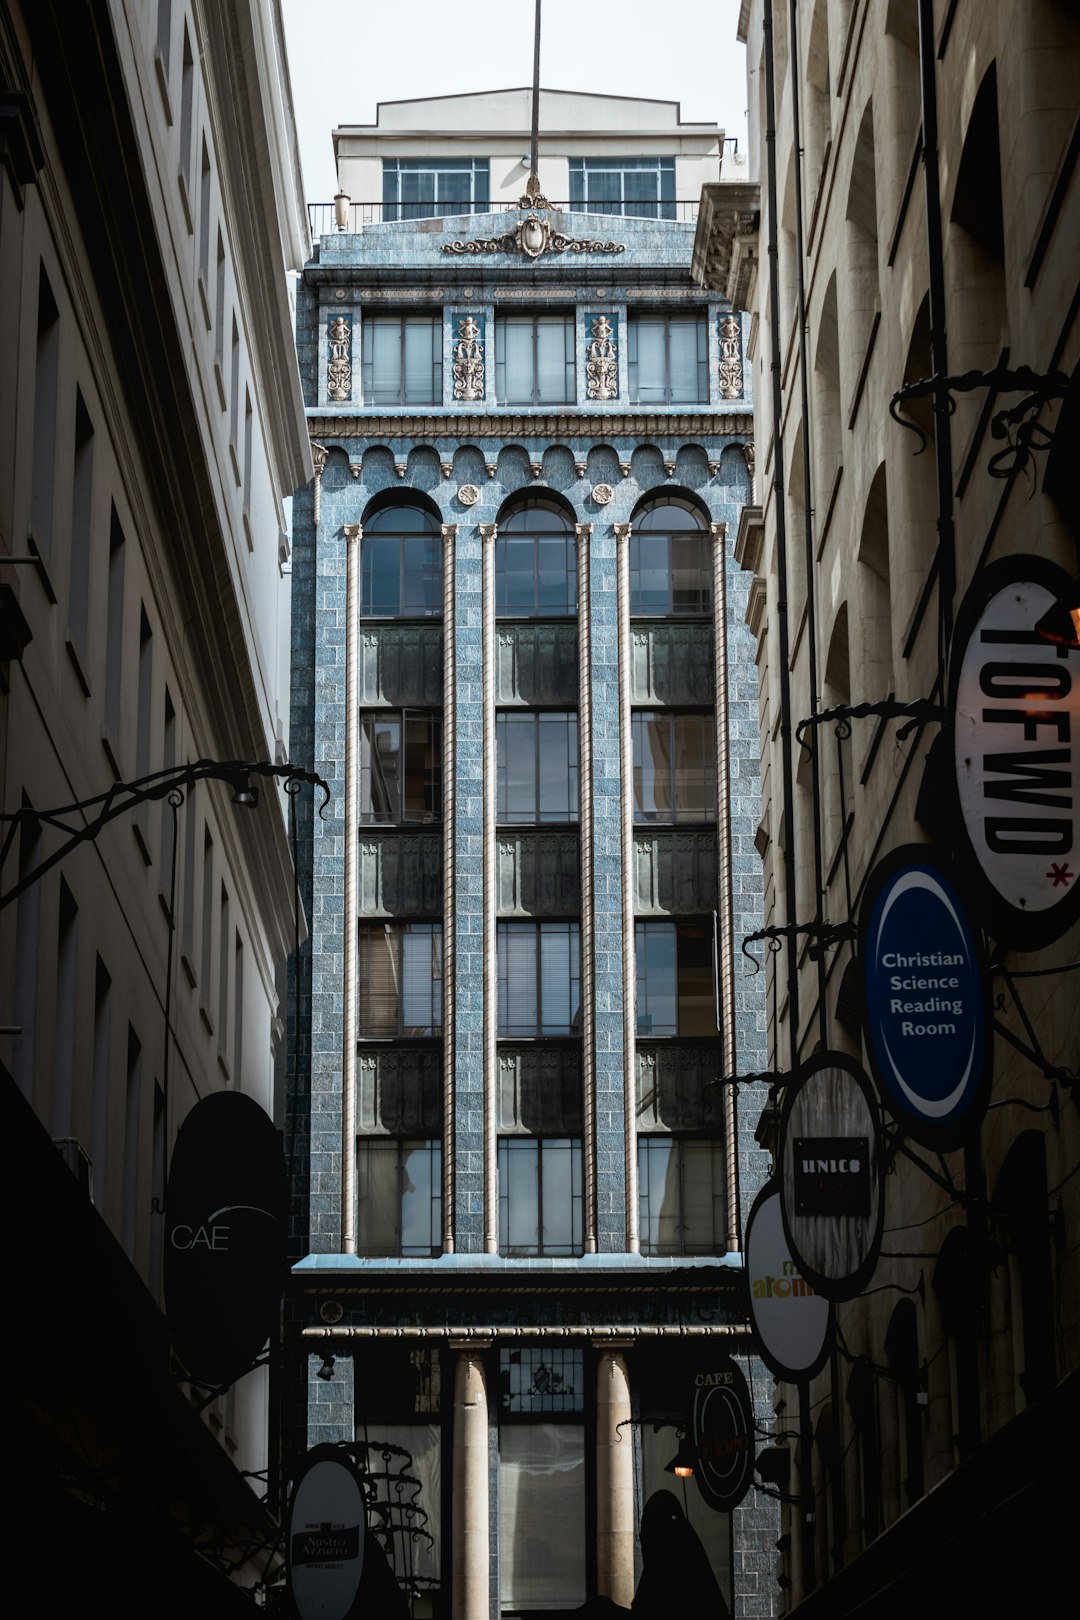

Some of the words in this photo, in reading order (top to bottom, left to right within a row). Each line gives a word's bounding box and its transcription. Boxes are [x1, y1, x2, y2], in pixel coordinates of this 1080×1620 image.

[881, 952, 964, 968] Christian
[890, 975, 960, 991] Science
[890, 997, 963, 1015] Reading
[901, 1021, 957, 1036] Room
[801, 1158, 862, 1174] UNICO
[171, 1224, 231, 1251] CAE
[753, 1276, 814, 1298] arom
[307, 1536, 347, 1547] Nastro
[302, 1545, 348, 1556] Azzurro
